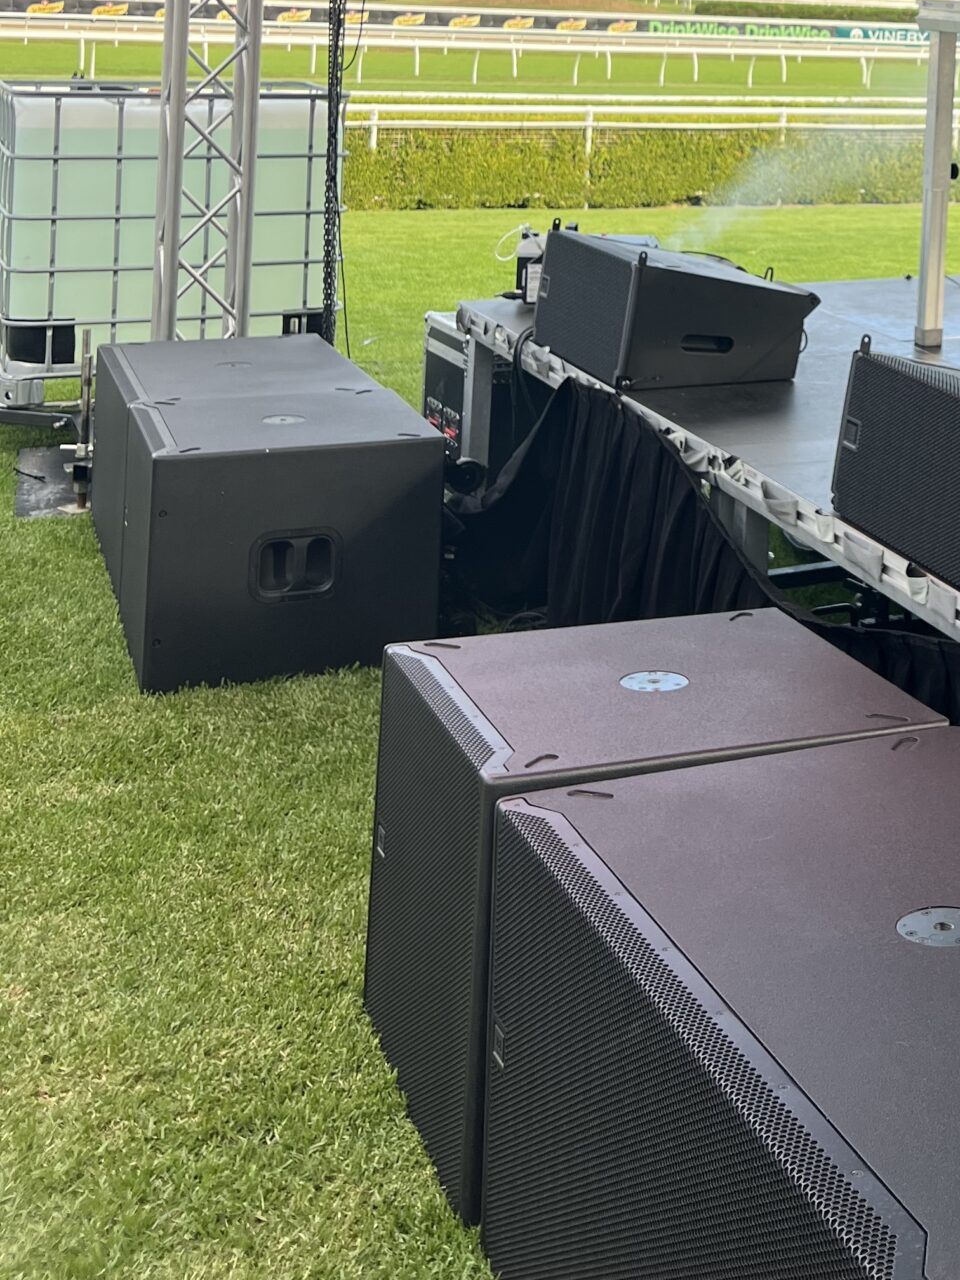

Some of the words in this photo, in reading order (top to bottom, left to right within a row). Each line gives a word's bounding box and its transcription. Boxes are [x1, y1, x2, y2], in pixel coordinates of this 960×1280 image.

[649, 20, 739, 36] DrinkWise
[745, 23, 831, 38] DrinkWise
[868, 30, 929, 43] VINERY
